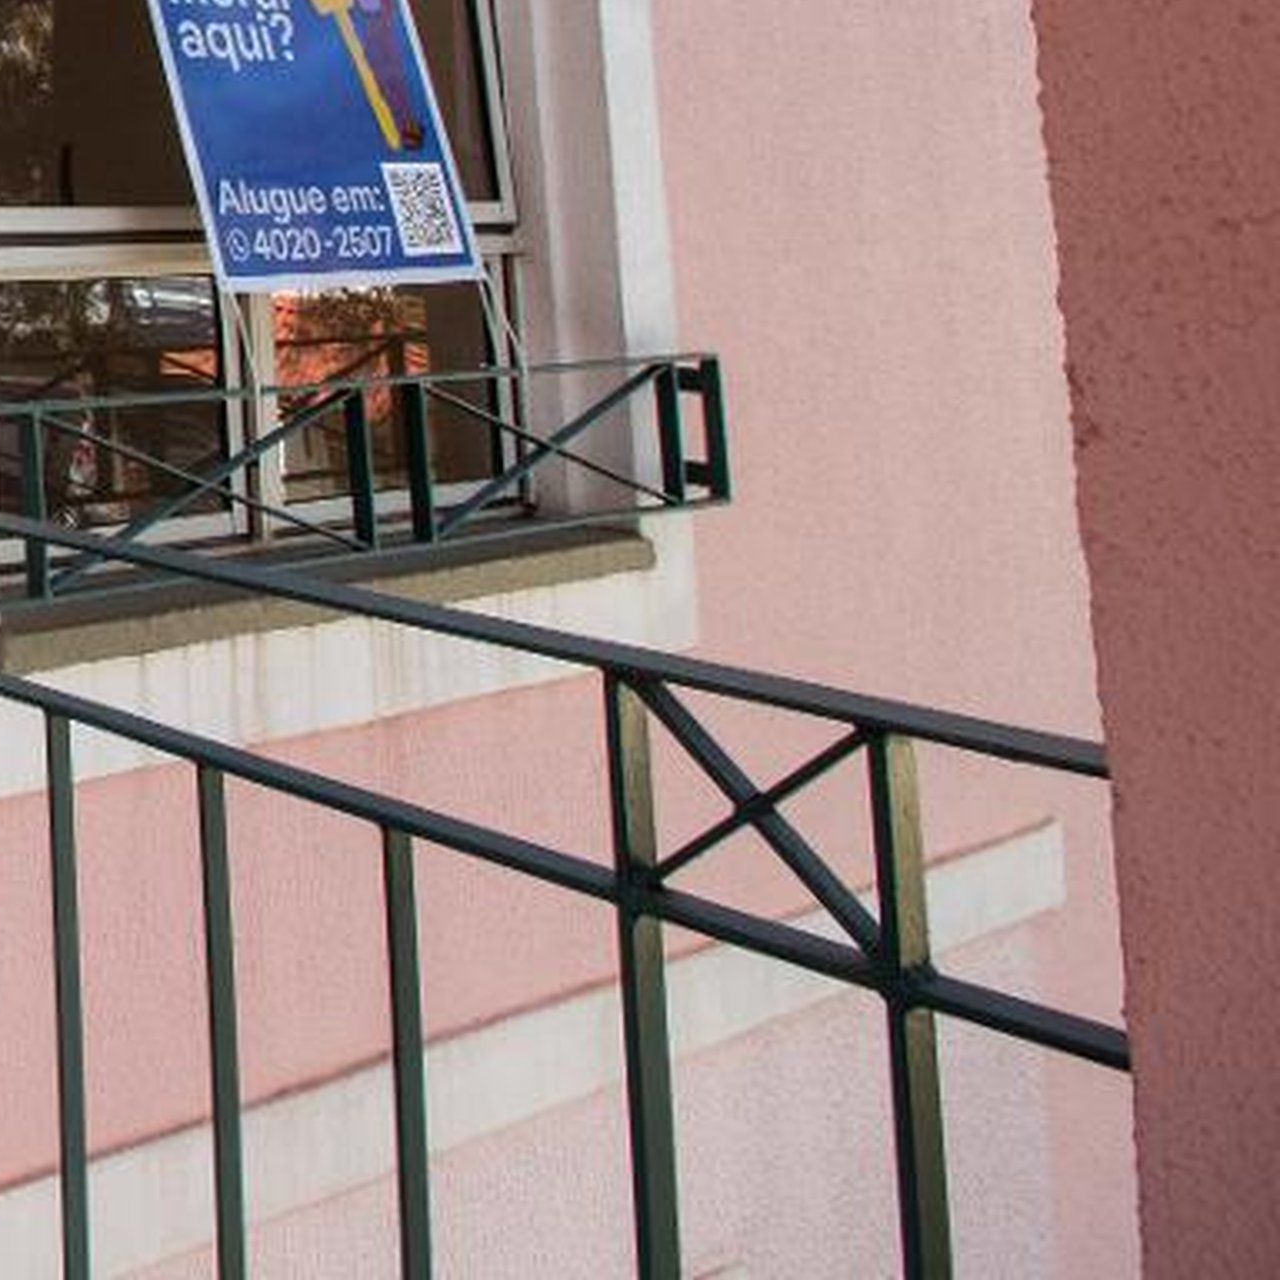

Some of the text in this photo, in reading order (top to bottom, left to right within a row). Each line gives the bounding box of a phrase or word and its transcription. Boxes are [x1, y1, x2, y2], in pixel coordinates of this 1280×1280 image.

[178, 11, 295, 72] aqui?
[219, 179, 385, 223] Alugue em:
